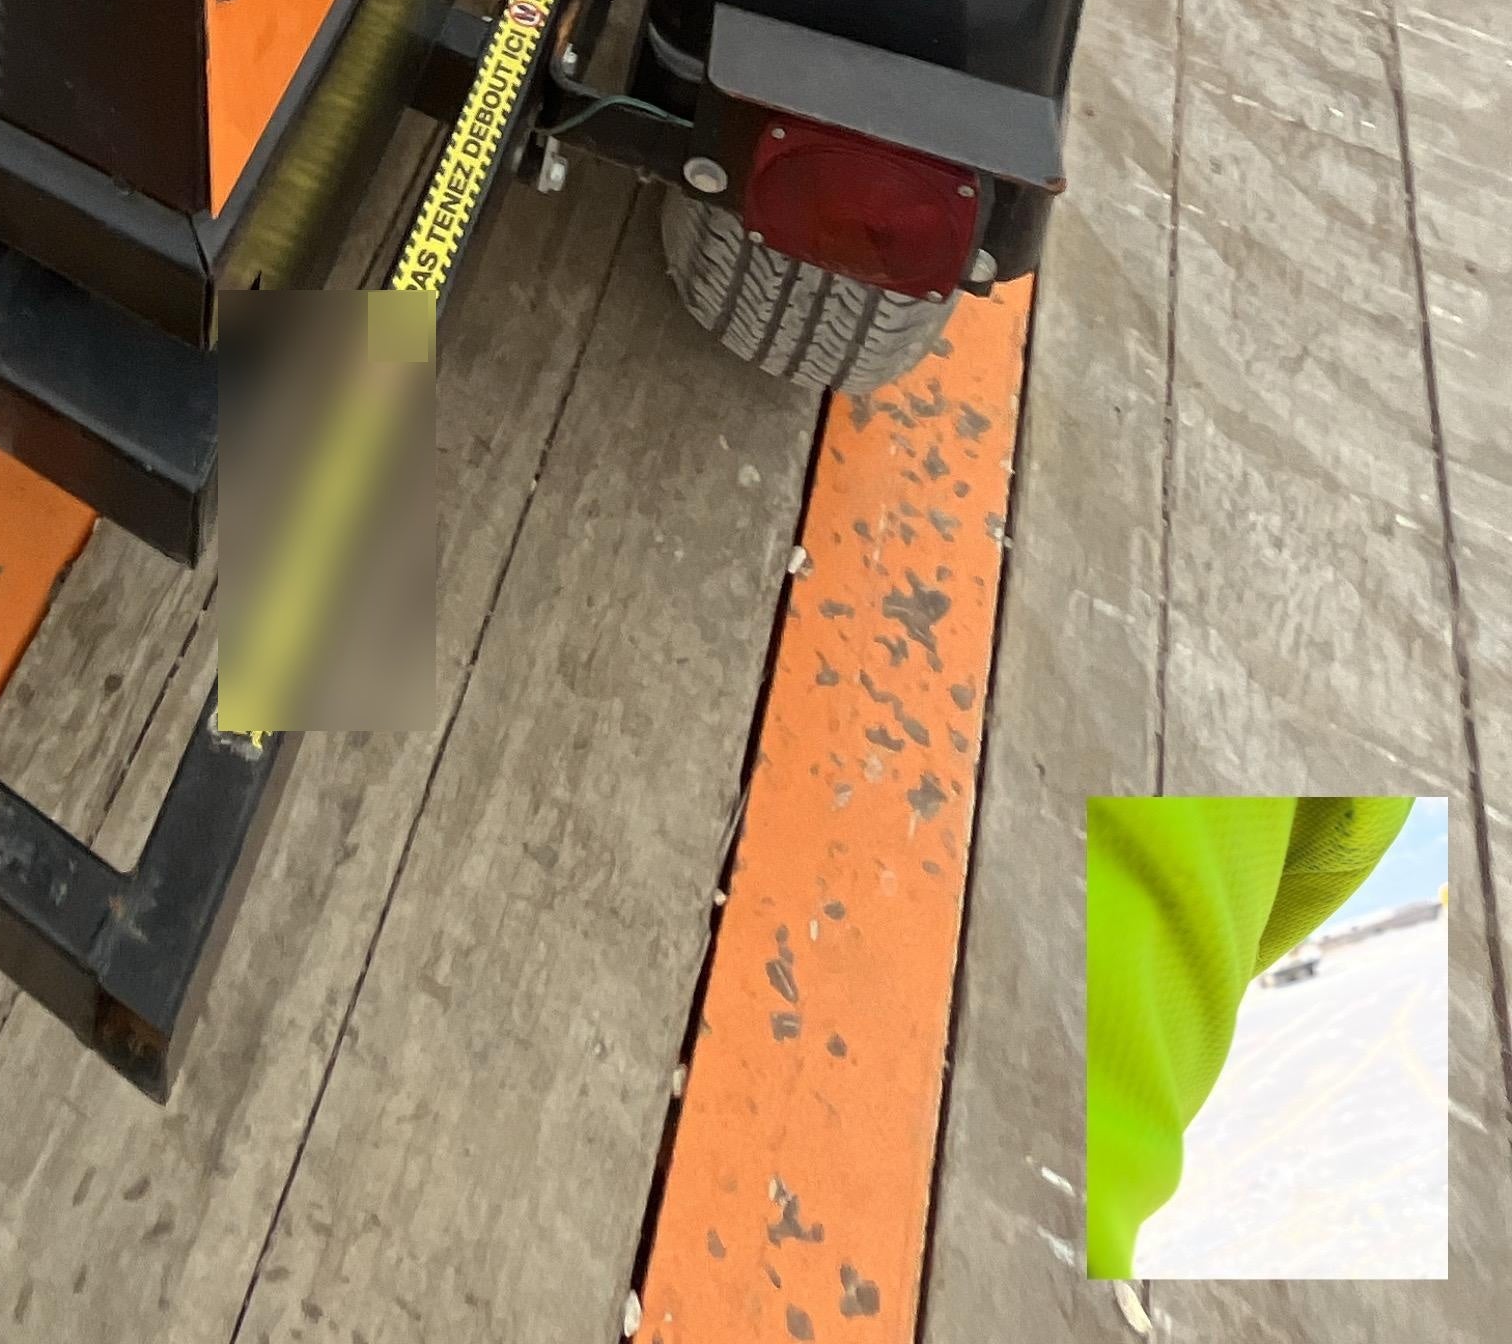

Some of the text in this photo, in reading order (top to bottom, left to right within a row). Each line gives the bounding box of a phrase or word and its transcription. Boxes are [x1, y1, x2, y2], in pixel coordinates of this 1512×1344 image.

[405, 27, 527, 290] AS TENEZ DEBOUT ICI
